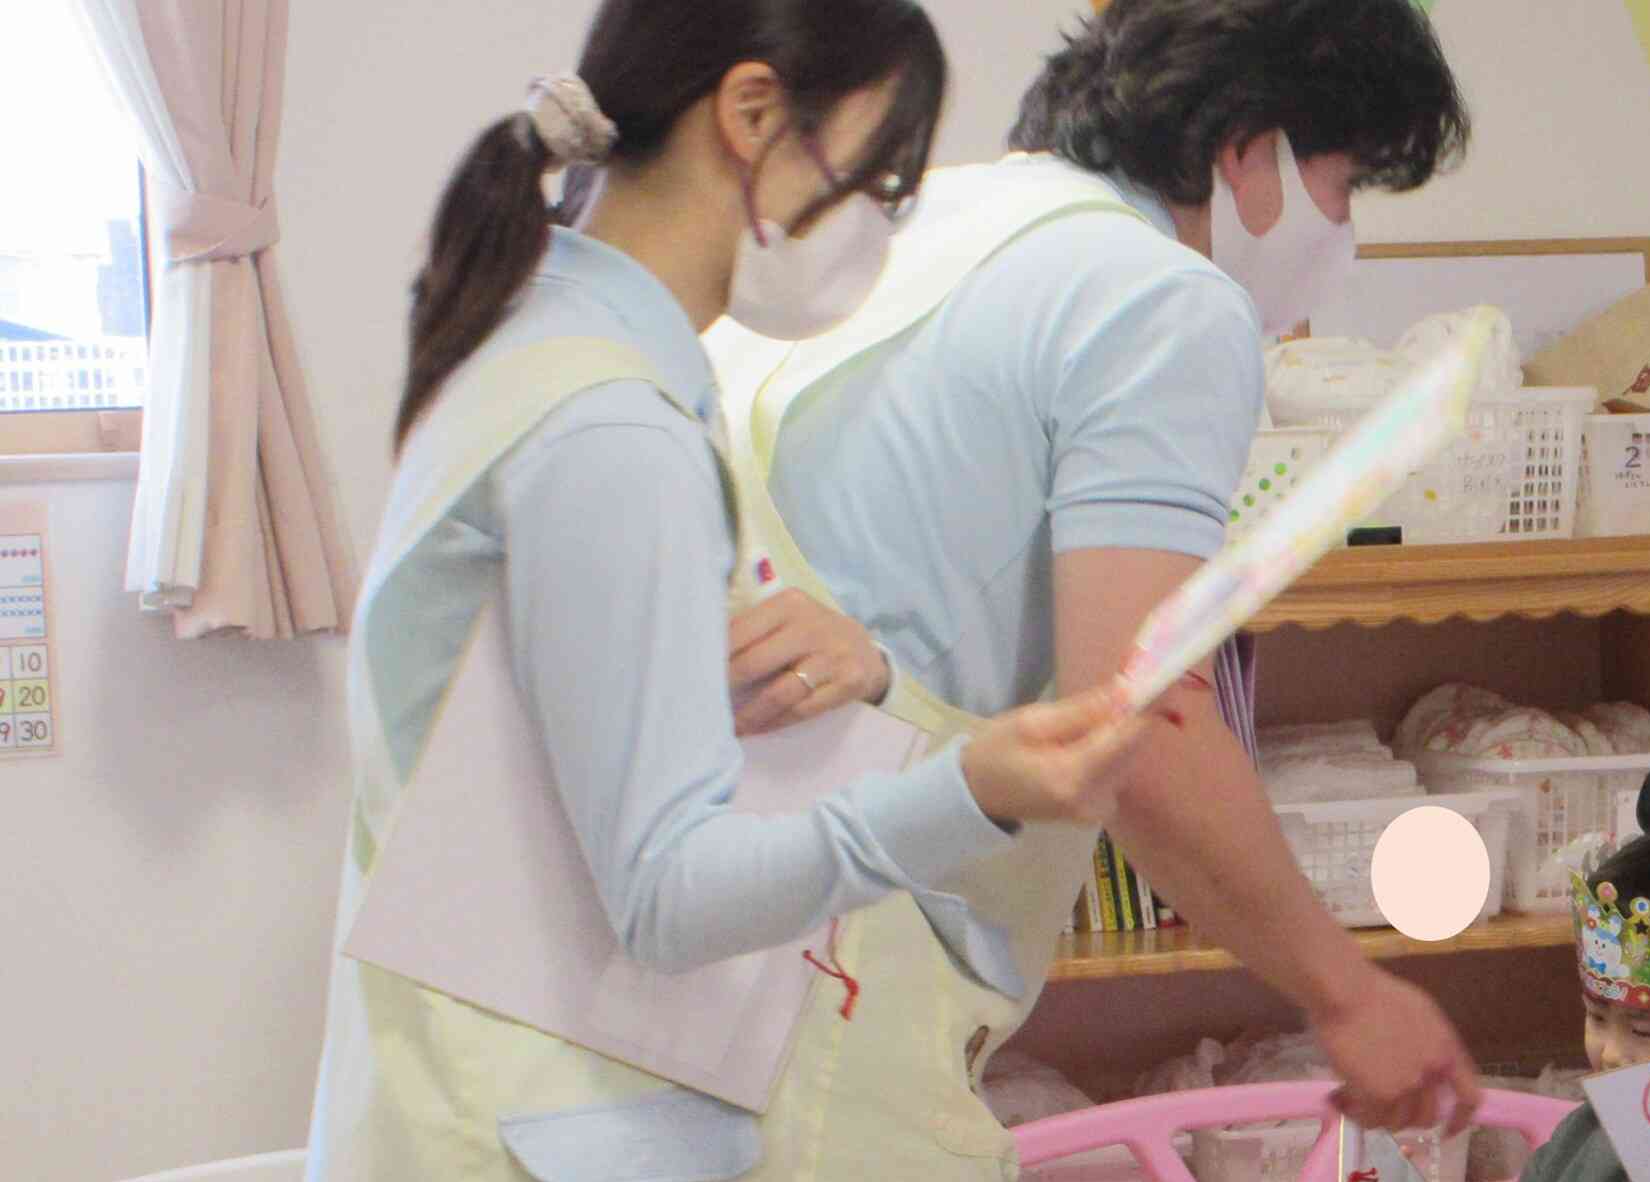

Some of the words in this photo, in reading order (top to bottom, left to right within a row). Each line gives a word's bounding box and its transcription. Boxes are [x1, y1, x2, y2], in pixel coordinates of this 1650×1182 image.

[1625, 446, 1641, 468] 2
[19, 651, 42, 673] 10
[18, 685, 46, 708] 20
[20, 719, 48, 742] 30
